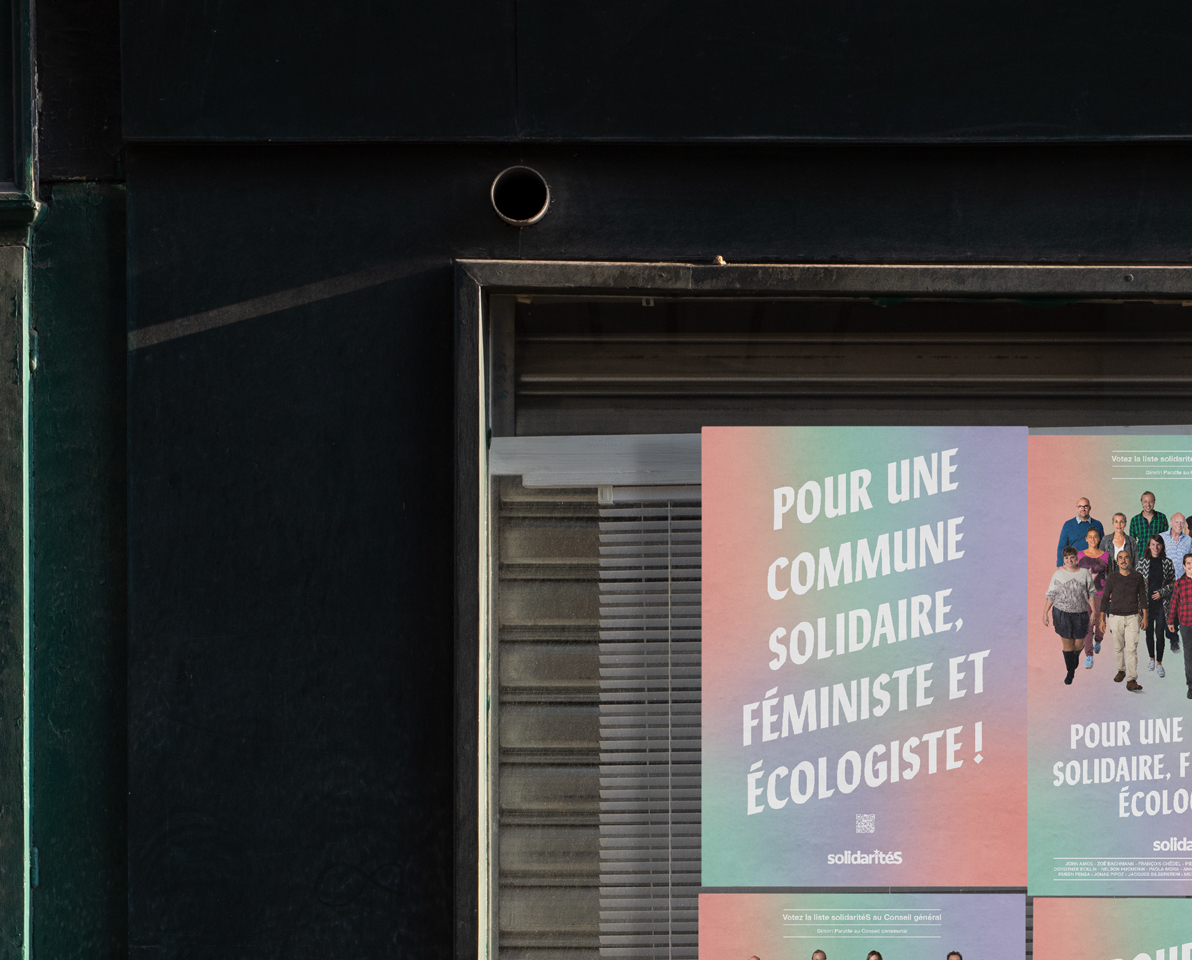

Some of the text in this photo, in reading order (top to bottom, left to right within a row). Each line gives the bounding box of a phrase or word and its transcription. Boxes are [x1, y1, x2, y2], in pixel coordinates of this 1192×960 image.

[773, 448, 959, 530] POUR UNE
[767, 516, 965, 600] COMMUNE
[769, 588, 963, 670] SOLIDAIRE,
[743, 649, 991, 747] FÉMINISTE ET
[1070, 721, 1131, 749] POUR
[1139, 717, 1184, 745] UNE
[747, 721, 983, 815] ÉCOLOGISTE !
[1053, 754, 1171, 787] SOLIDAIRE,
